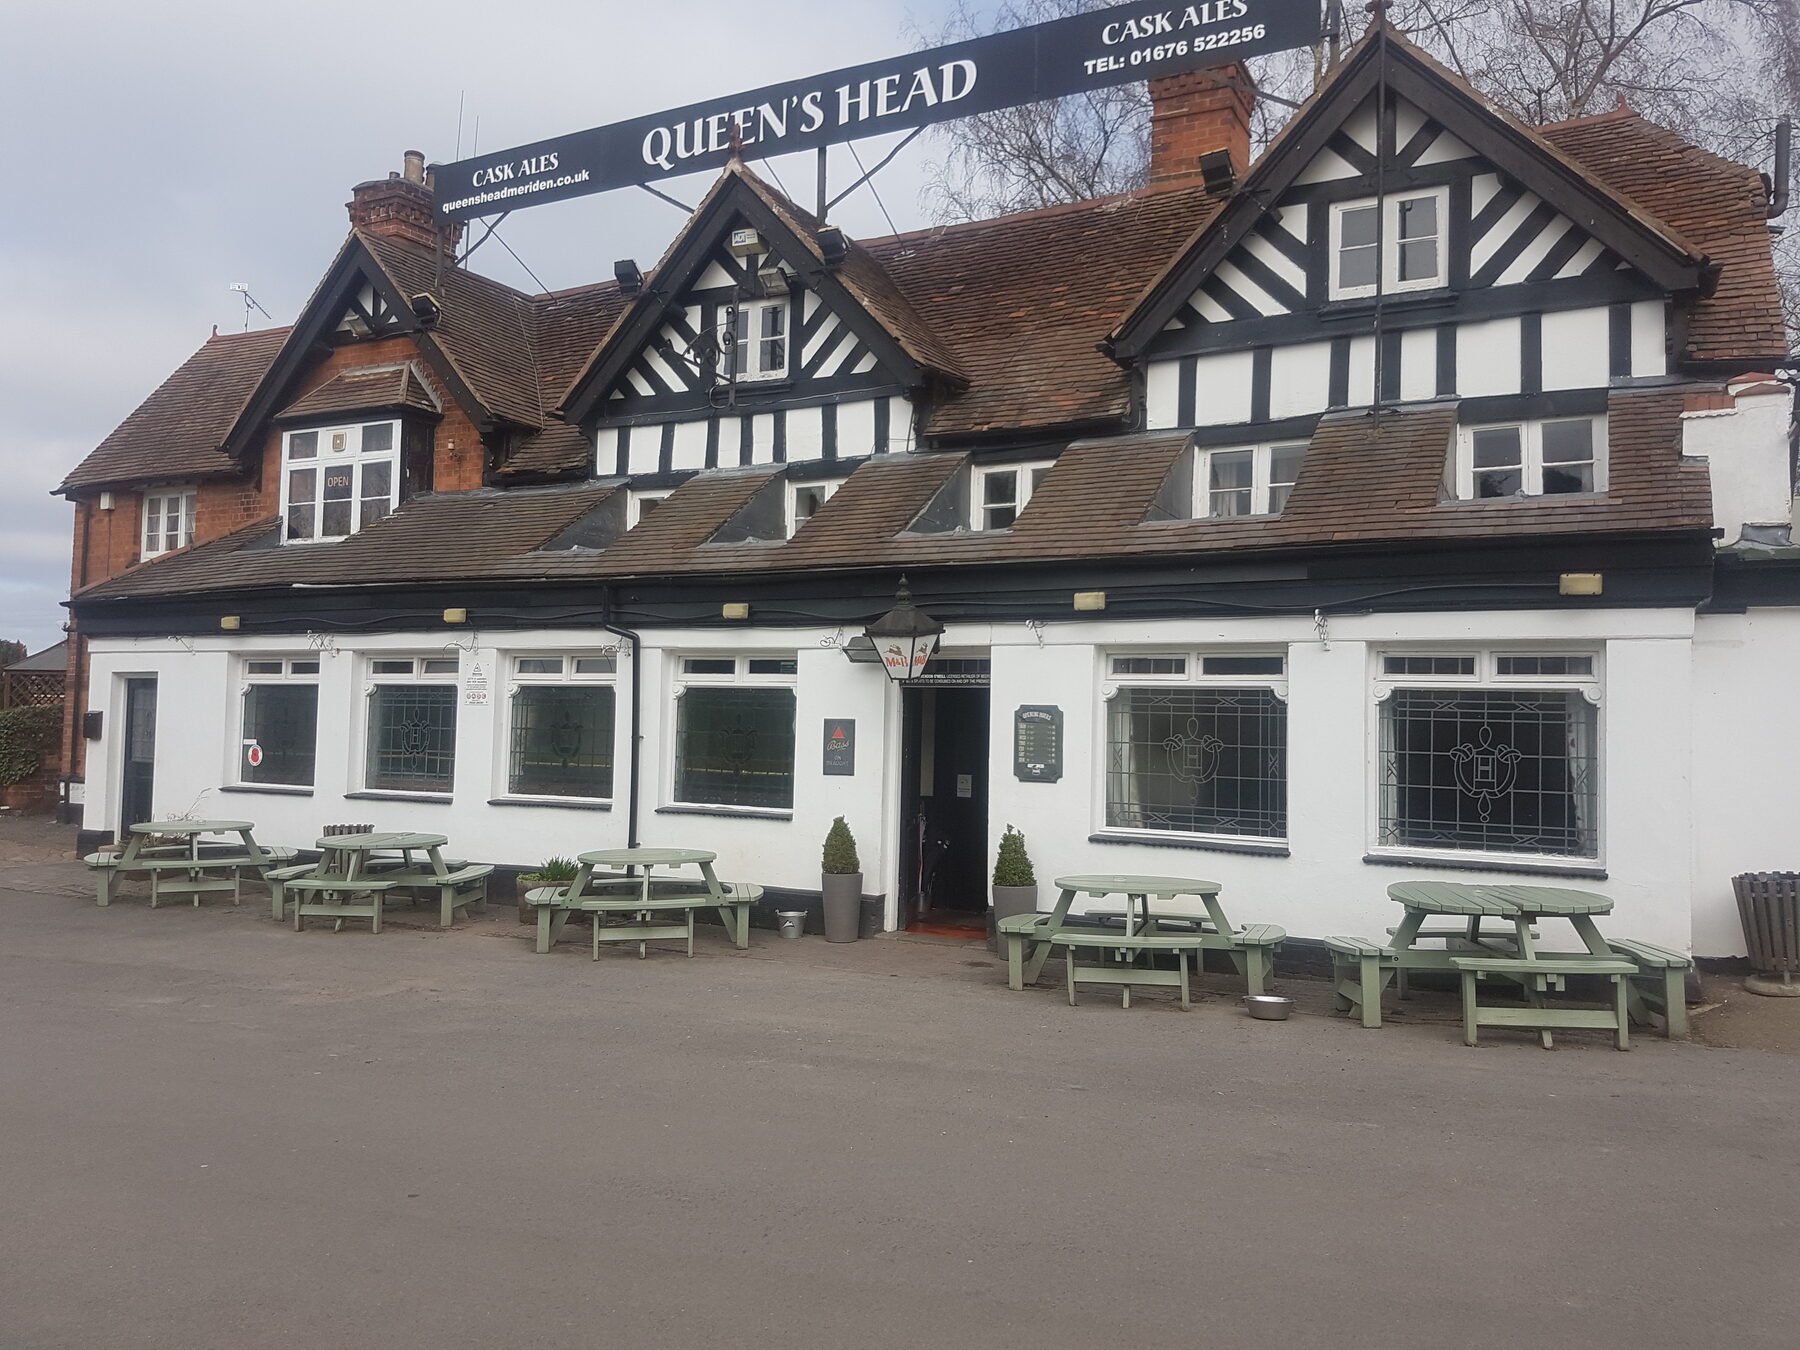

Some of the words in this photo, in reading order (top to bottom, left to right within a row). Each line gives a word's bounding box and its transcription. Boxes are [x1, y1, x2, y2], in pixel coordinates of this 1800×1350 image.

[1101, 11, 1172, 46] CASK
[1178, 0, 1249, 31] ALES
[1084, 57, 1125, 76] TEL:
[1130, 40, 1188, 67] 01676
[1193, 24, 1266, 53] 522256
[642, 91, 824, 171] QUEEN'S
[835, 59, 978, 126] HEAD
[442, 169, 590, 214] queensheadmeriden.co.uk
[472, 162, 514, 188] CASK
[518, 152, 559, 178] ALES
[327, 476, 349, 488] OPEN
